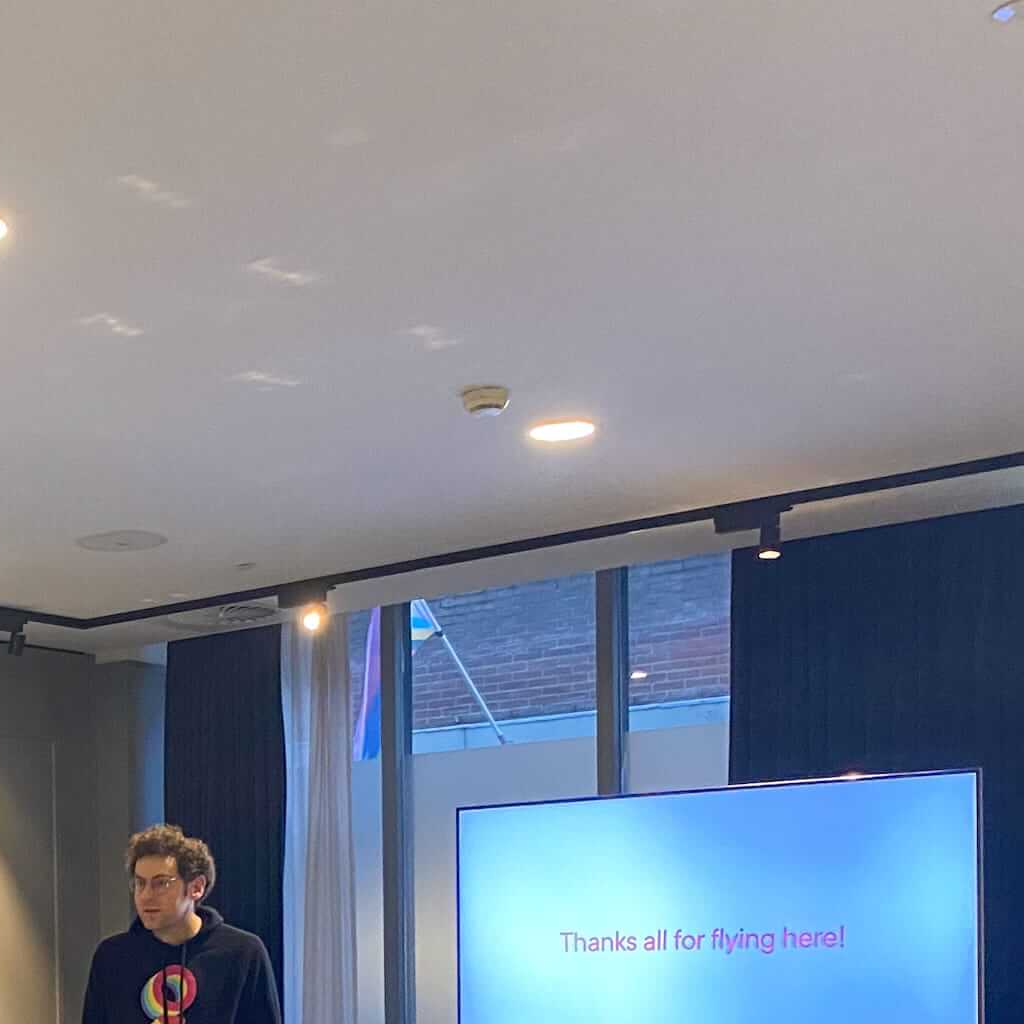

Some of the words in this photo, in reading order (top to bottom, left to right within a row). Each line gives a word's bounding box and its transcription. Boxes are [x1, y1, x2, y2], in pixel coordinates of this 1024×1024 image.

[560, 930, 637, 952] Thanks
[643, 928, 667, 951] all
[673, 928, 706, 950] for
[711, 927, 775, 954] flying
[782, 925, 845, 949] here!
